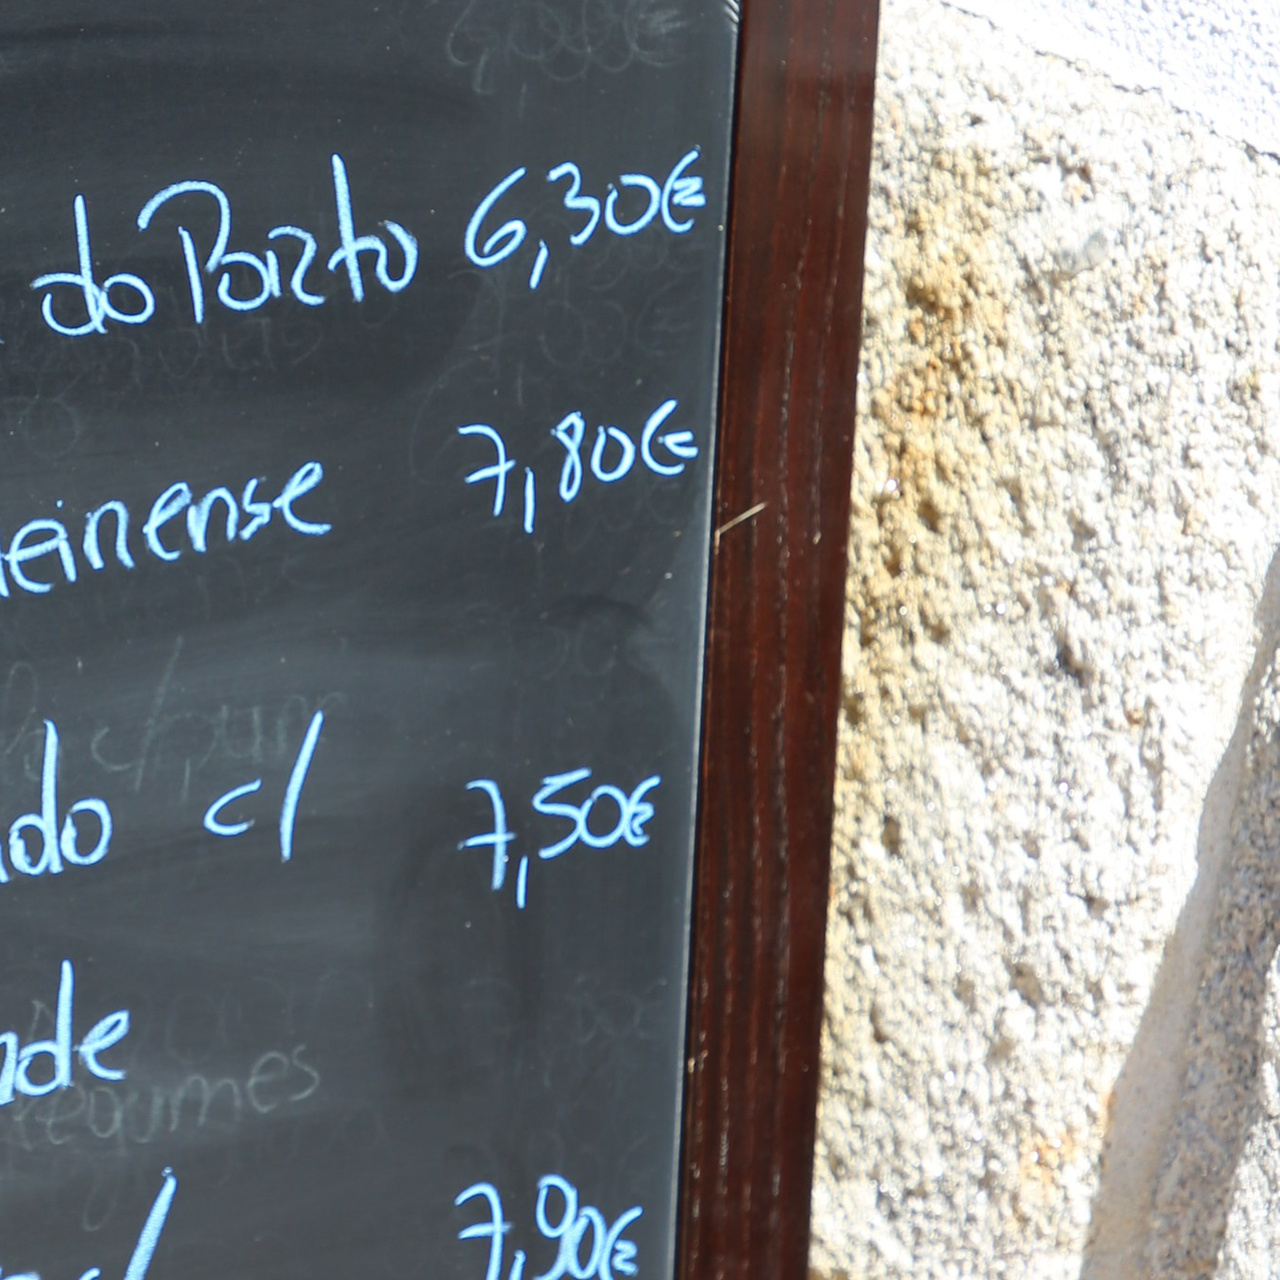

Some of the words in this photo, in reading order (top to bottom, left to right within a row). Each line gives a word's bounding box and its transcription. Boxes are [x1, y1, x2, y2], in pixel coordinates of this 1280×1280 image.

[31, 195, 155, 336] do
[465, 147, 706, 290] 6,30€
[457, 400, 699, 534] 7,80€
[458, 767, 662, 909] 7,50€
